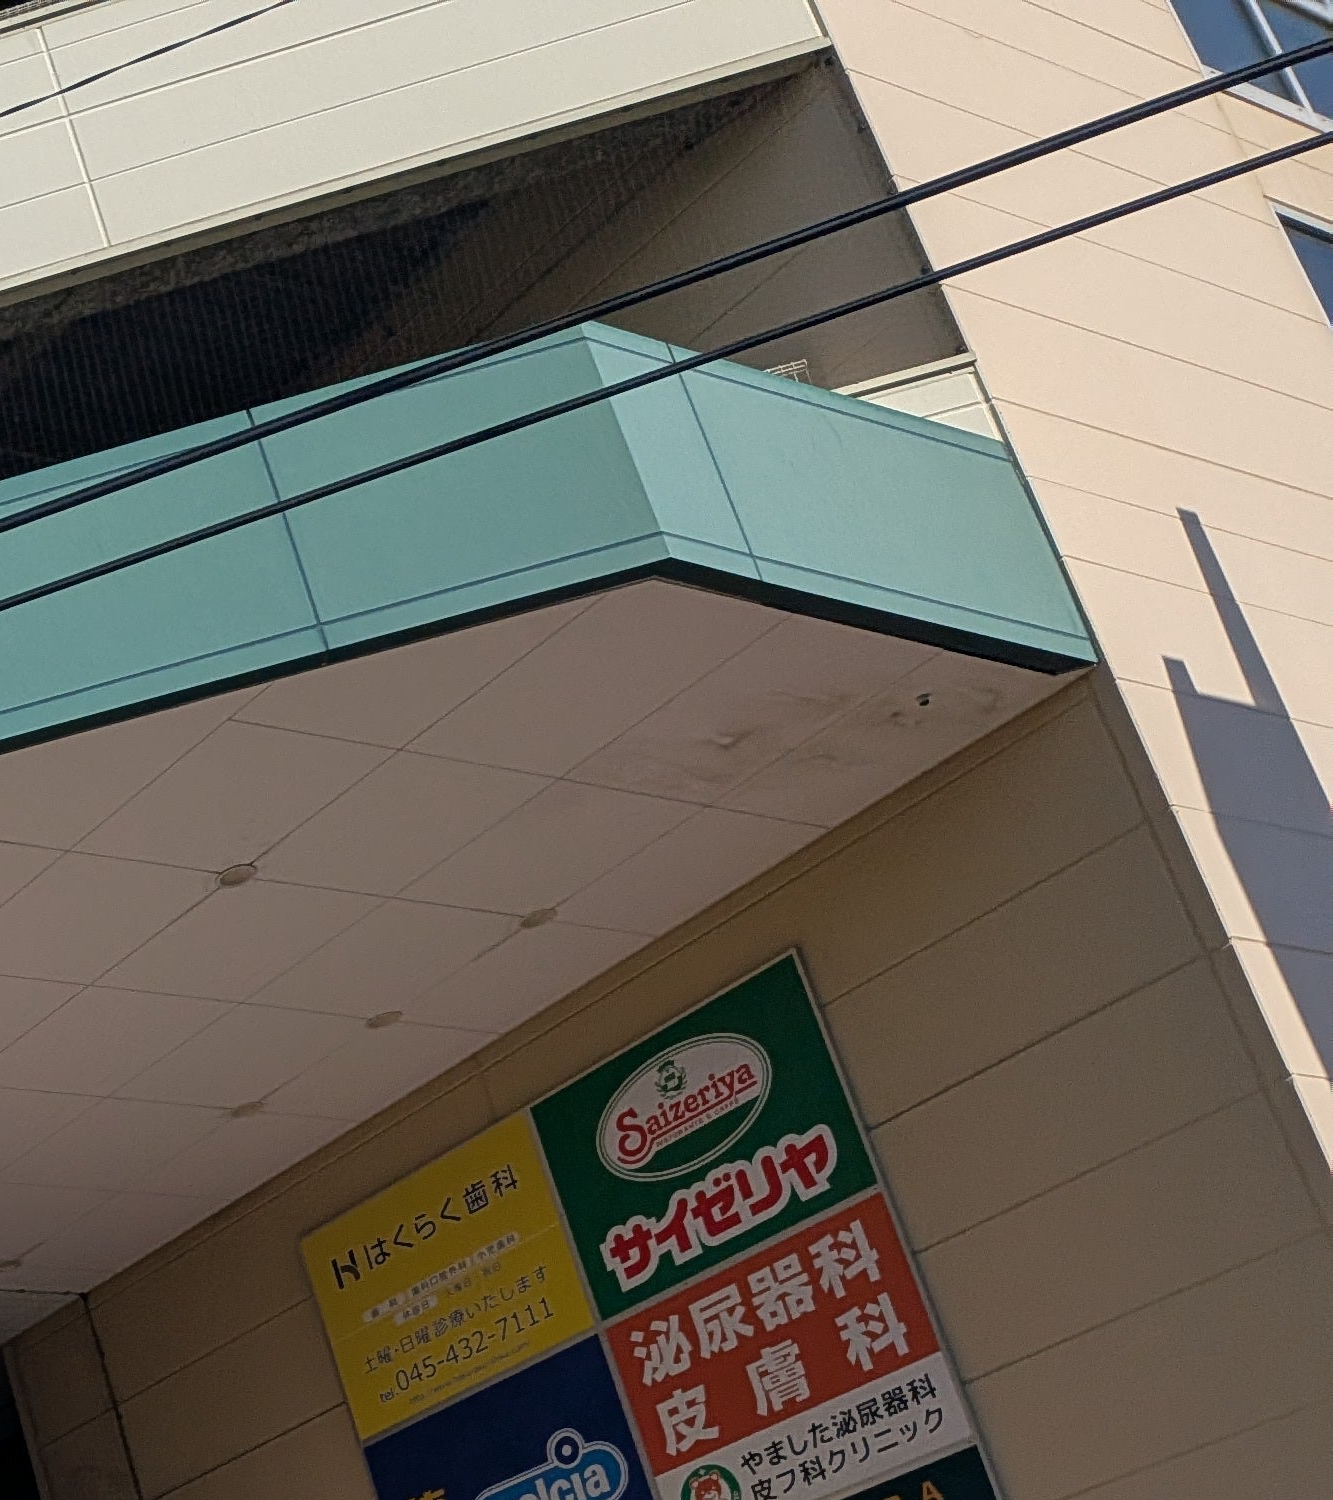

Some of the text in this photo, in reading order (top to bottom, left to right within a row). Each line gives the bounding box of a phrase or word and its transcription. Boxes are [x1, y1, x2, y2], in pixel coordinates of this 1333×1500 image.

[616, 1063, 755, 1160] Saizeriya
[363, 1164, 518, 1270] はくらく歯科
[606, 1130, 832, 1283] サイゼリヤ
[395, 1297, 554, 1391] 045-432-7111
[629, 1219, 881, 1387] 泌尿器科
[741, 1373, 937, 1475] やました泌尿器科
